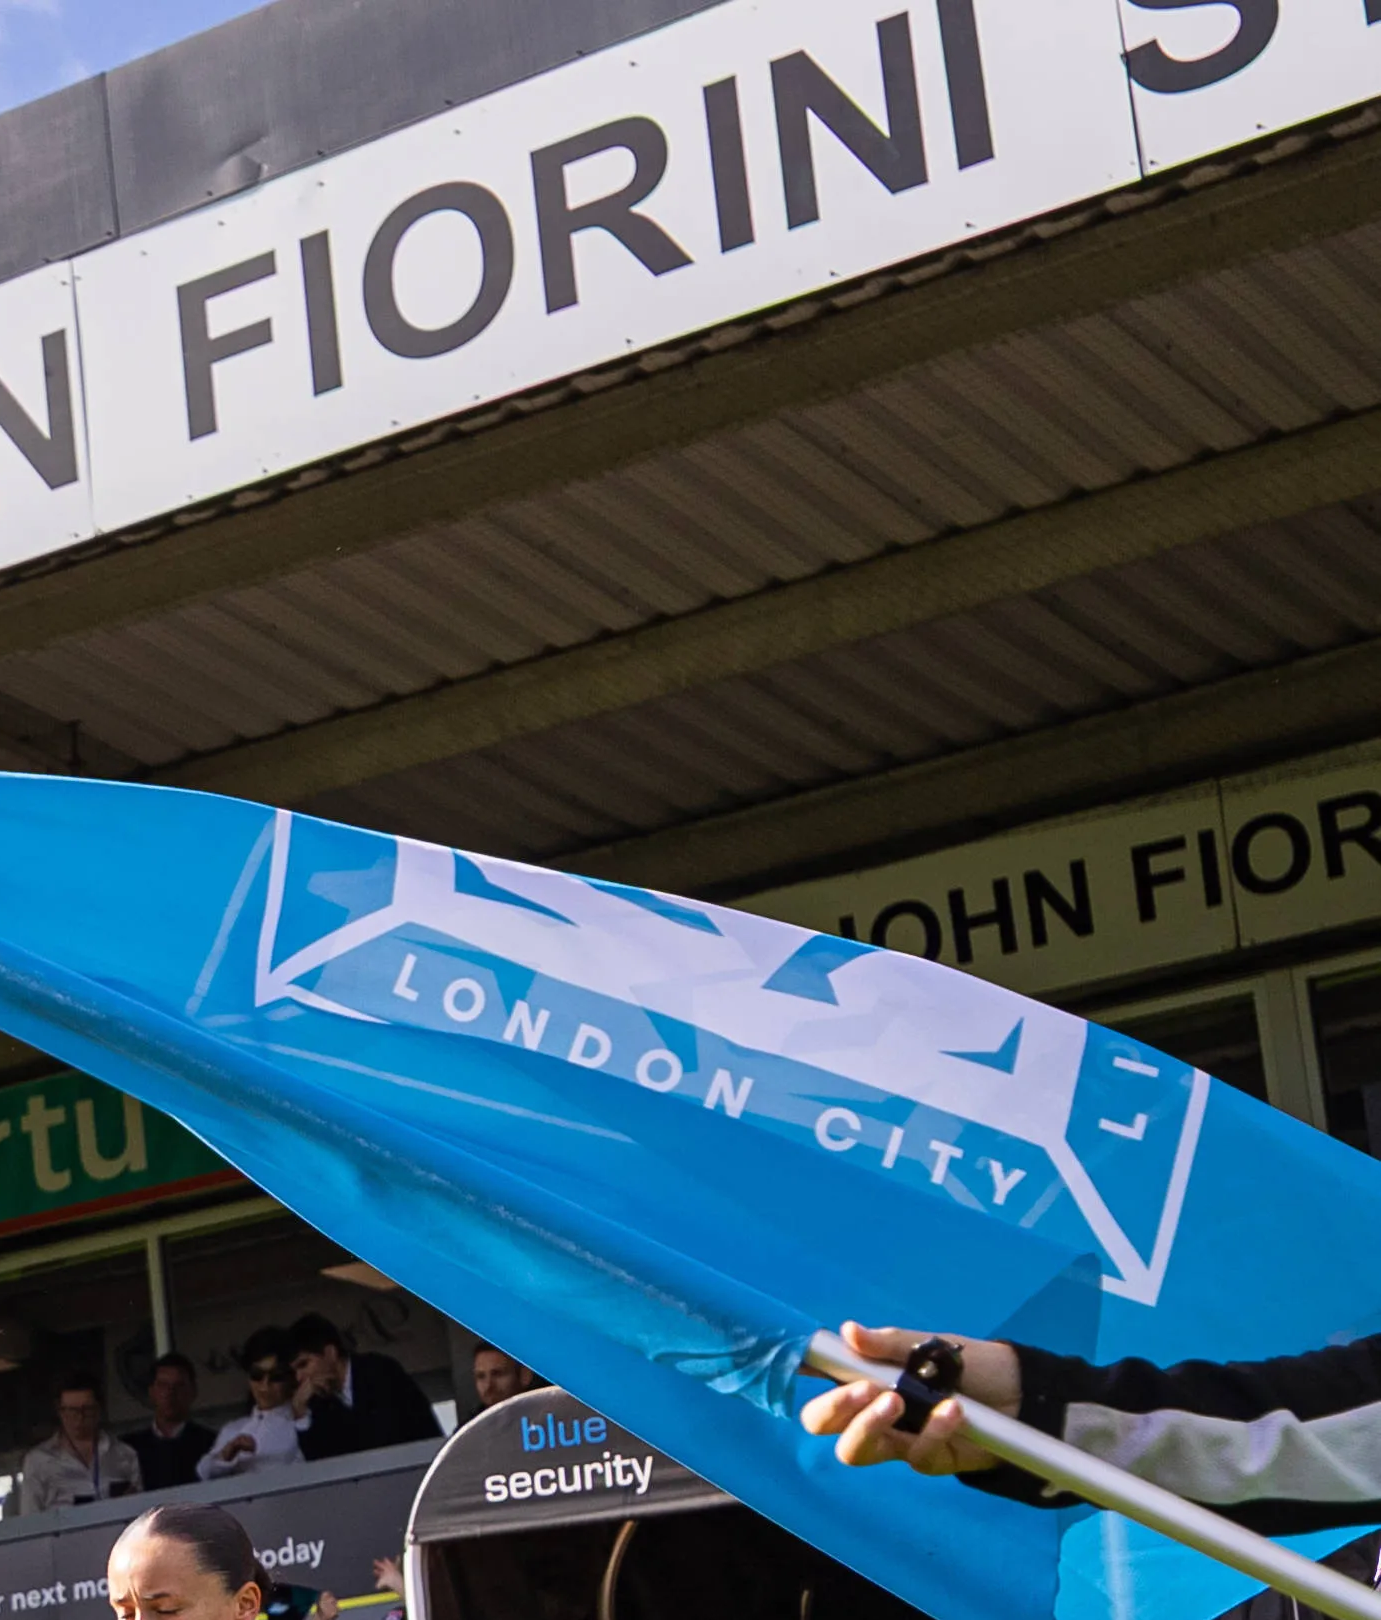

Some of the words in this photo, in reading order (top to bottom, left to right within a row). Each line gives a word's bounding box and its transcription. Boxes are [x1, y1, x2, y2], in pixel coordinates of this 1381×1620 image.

[176, 0, 995, 440] FIORINI
[393, 953, 755, 1120] LONDON
[815, 1107, 1027, 1206] CITY
[521, 1413, 607, 1451] blue
[484, 1451, 653, 1503] security
[11, 1580, 67, 1612] next
